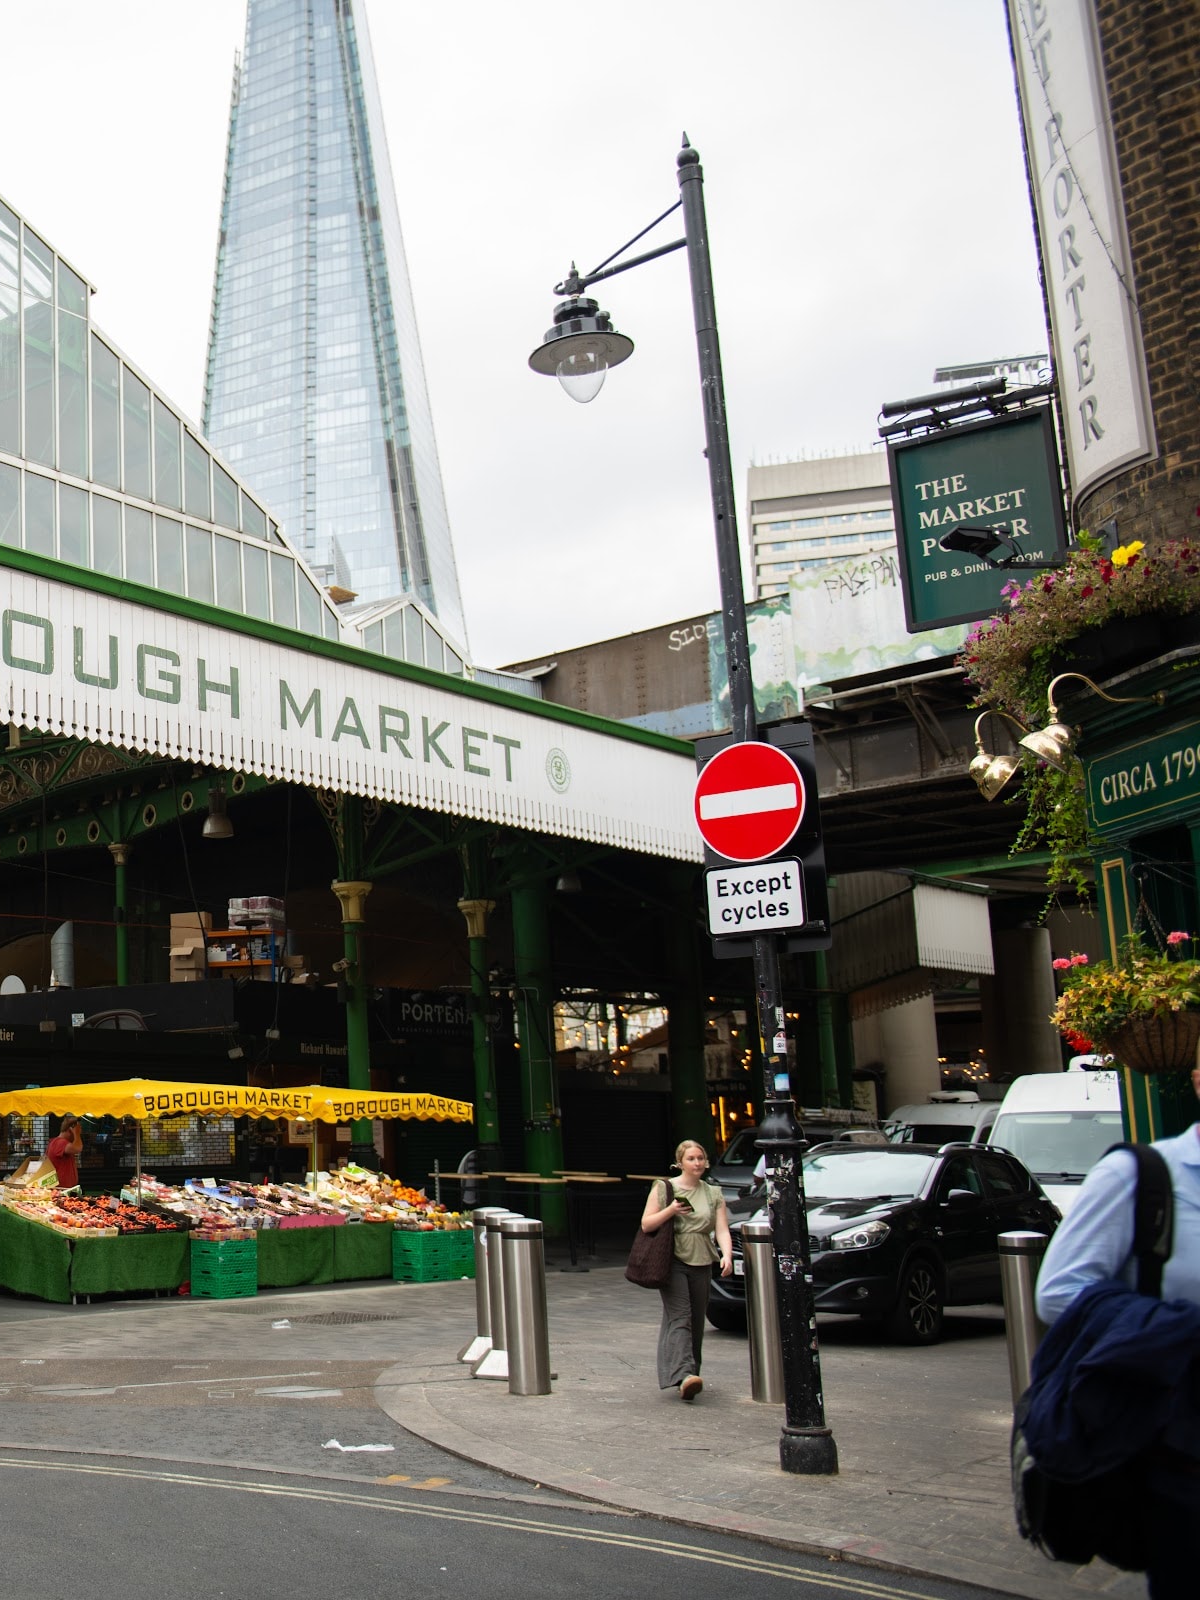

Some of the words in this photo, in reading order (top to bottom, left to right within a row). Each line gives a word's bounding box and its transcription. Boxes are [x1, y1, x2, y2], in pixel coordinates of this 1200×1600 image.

[1044, 111, 1105, 452] PORTER
[915, 474, 968, 501] THE
[918, 488, 1026, 530] MARKET
[924, 571, 948, 583] PUB
[950, 568, 962, 578] &
[279, 678, 522, 783] MARKET
[1100, 760, 1158, 806] CIRCA
[1161, 743, 1200, 787] 179
[716, 871, 792, 898] Except
[721, 899, 790, 925] cycles
[143, 1091, 238, 1112] BOROUGH
[244, 1091, 312, 1110] MARKET
[333, 1097, 412, 1117] BOROUGH
[416, 1097, 474, 1117] MARKET
